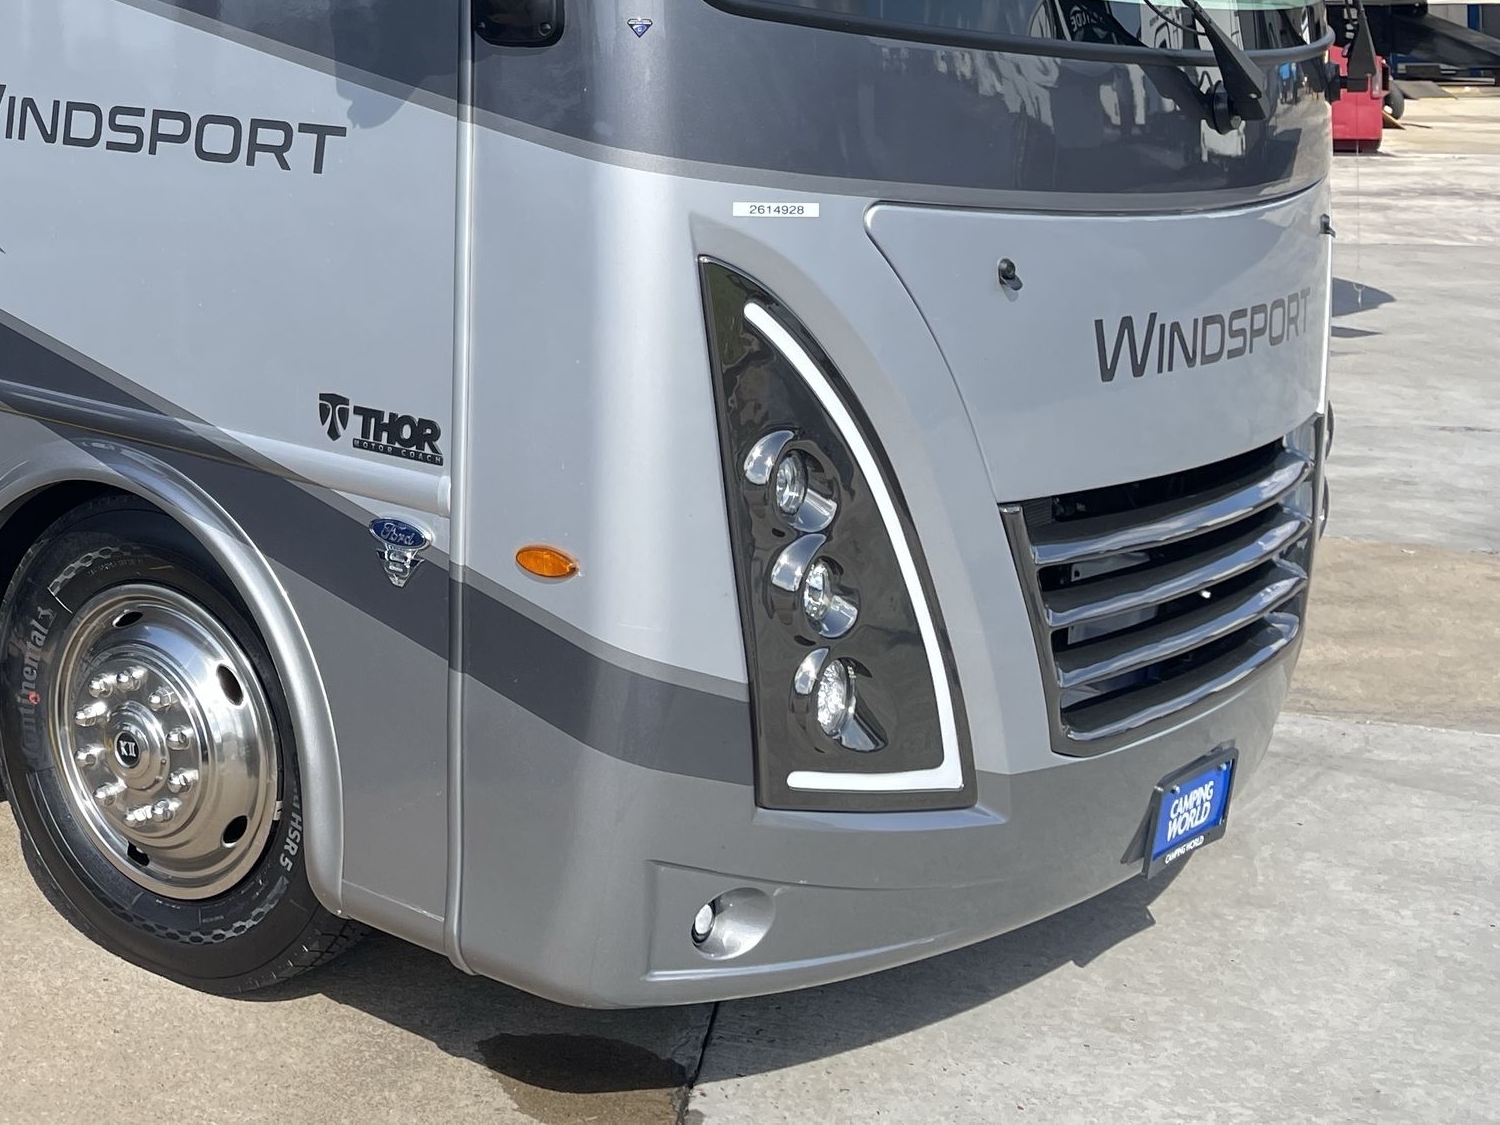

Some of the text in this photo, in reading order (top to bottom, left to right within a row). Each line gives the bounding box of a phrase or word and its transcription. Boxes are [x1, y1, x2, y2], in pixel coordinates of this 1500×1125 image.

[749, 204, 804, 215] 2614928
[1094, 287, 1311, 383] WINDSPORT
[353, 405, 443, 456] THOR
[354, 439, 441, 463] MOTOR COACH
[380, 522, 416, 546] Ford
[1170, 780, 1215, 819] CAMPING
[284, 812, 303, 856] HSR
[1167, 801, 1211, 842] WORLD
[279, 853, 293, 872] 5
[1164, 835, 1205, 864] CAMPING WORLD
